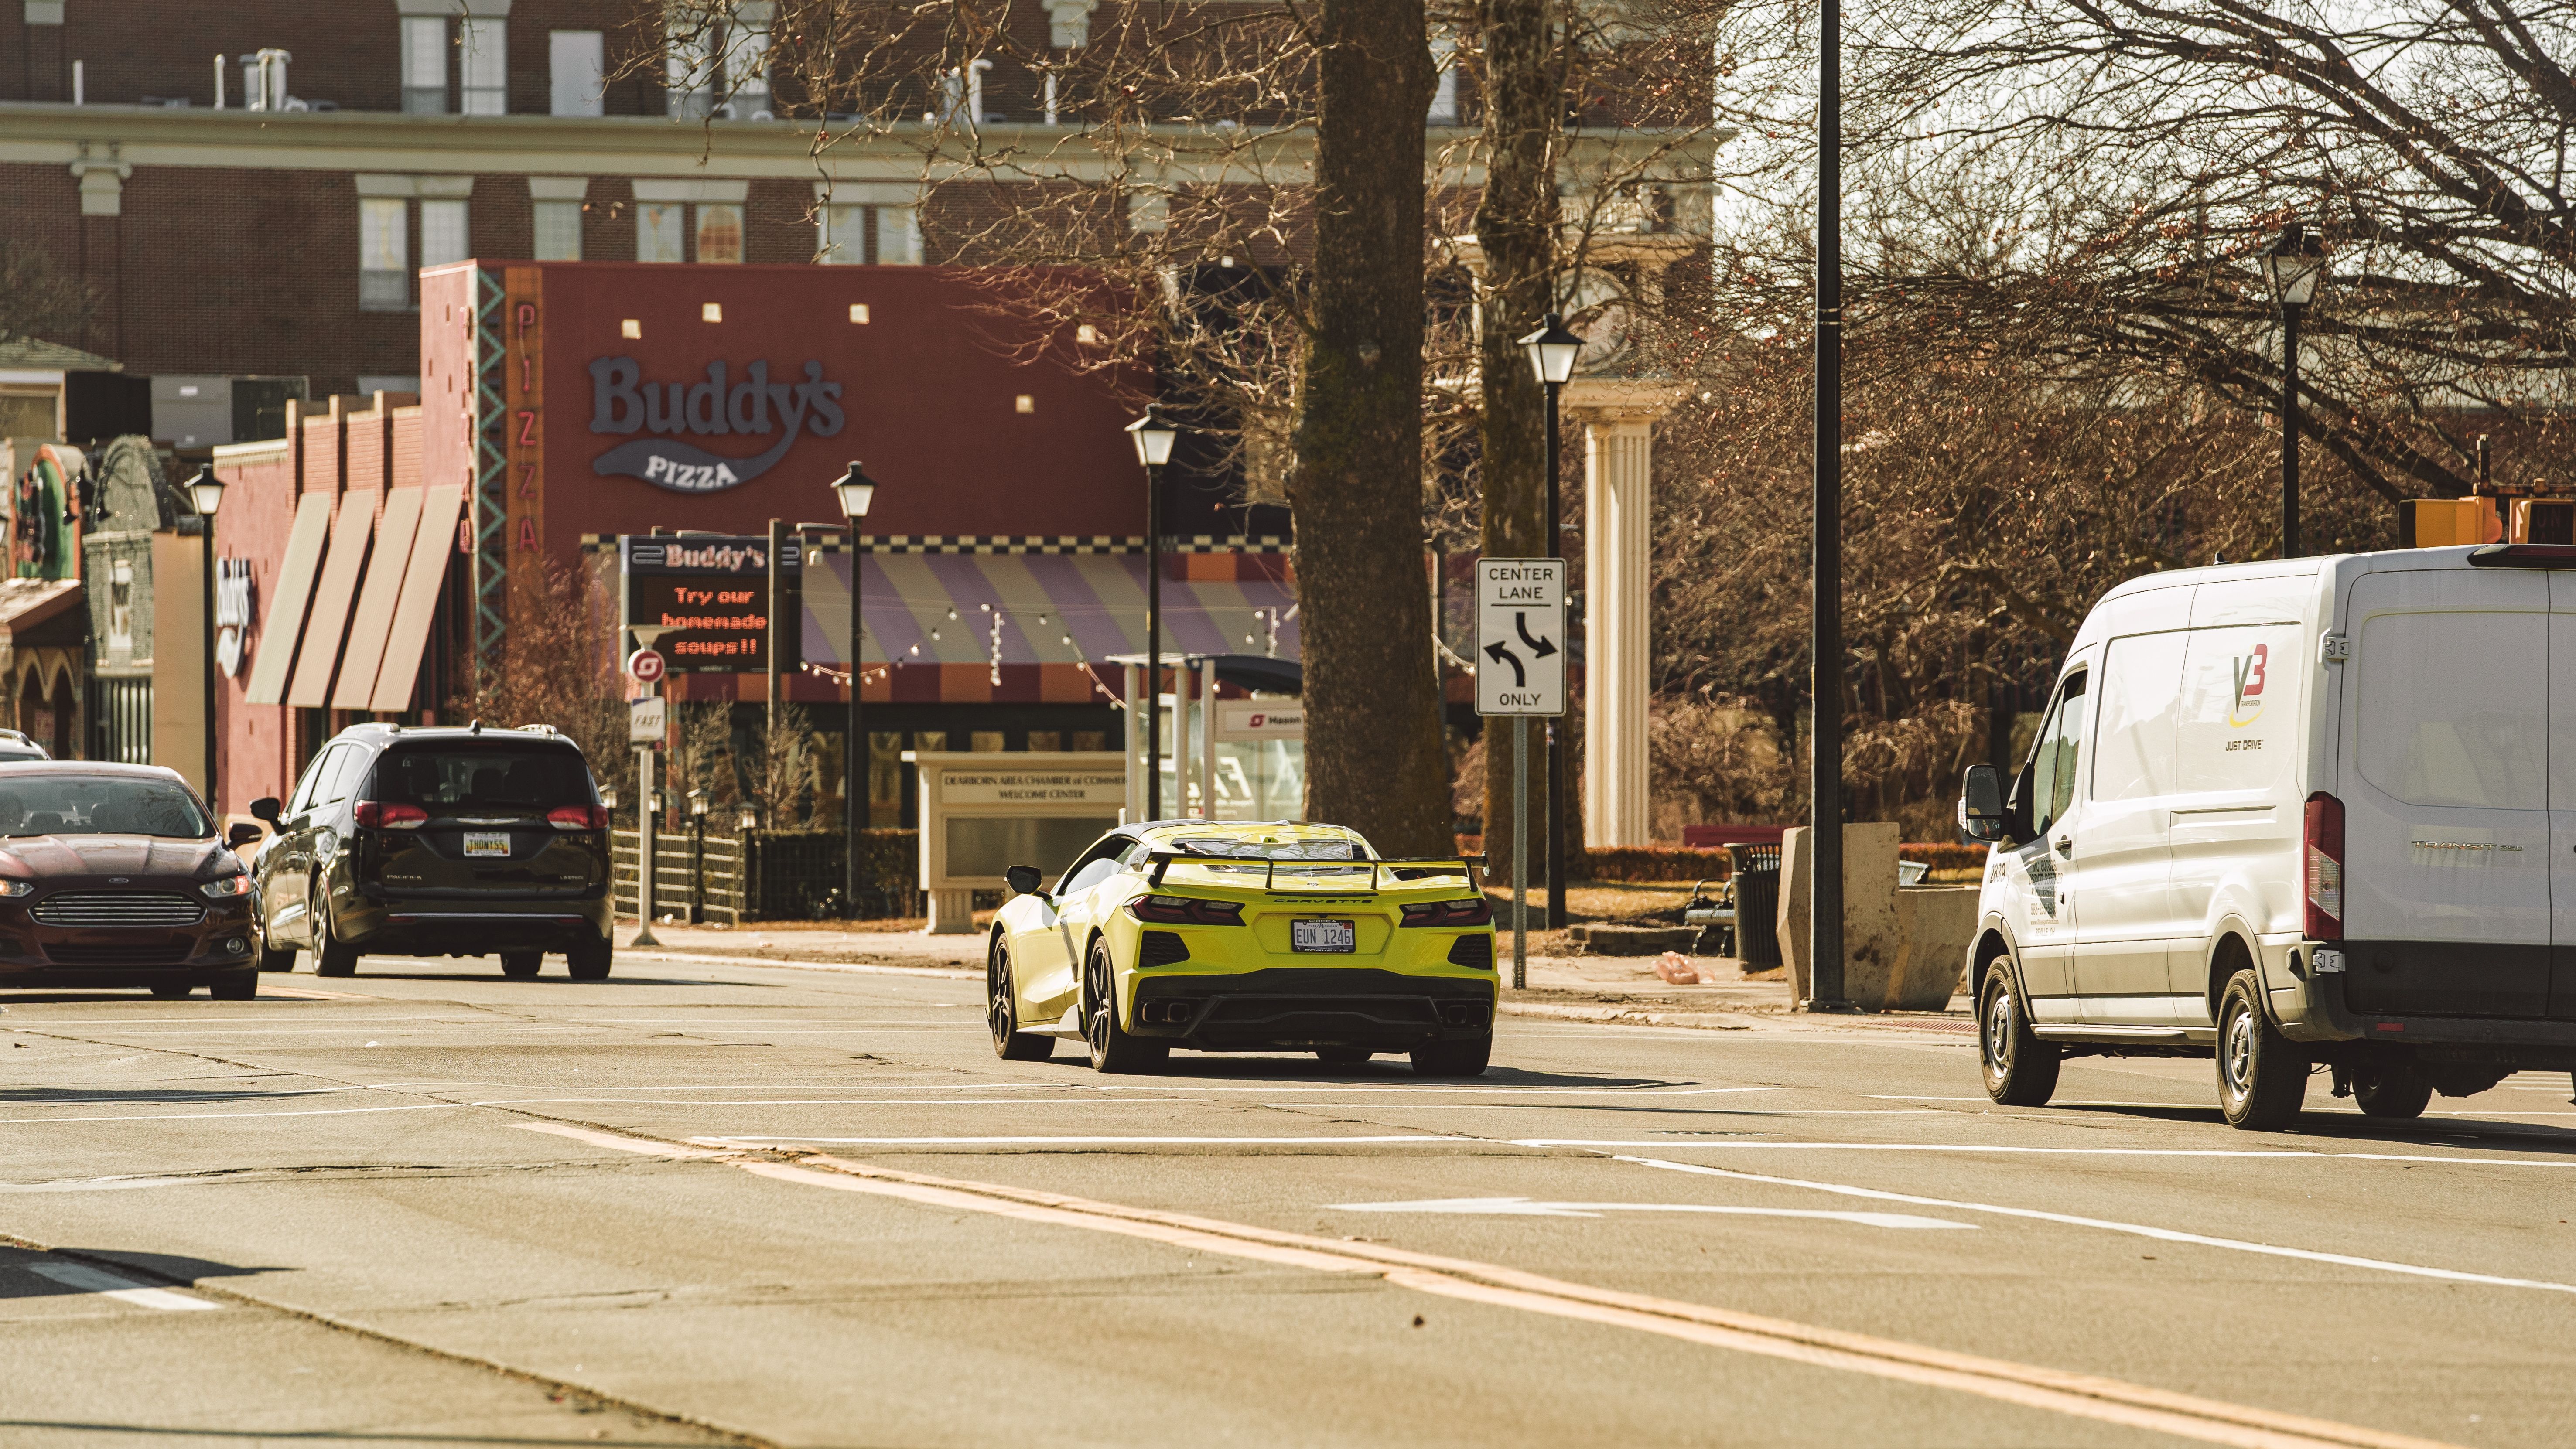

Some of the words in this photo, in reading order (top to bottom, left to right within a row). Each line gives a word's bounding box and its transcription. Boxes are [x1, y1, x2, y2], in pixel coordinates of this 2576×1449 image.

[588, 357, 845, 436] Buddy's
[518, 304, 539, 552] PIZZA
[645, 454, 738, 489] PIZZA
[665, 544, 765, 572] Buddy's
[1489, 568, 1553, 580] CENTER
[674, 587, 713, 606] Try
[717, 591, 755, 604] our
[1499, 587, 1543, 599] LANE
[674, 638, 757, 656] soups!!
[2233, 644, 2268, 714] V3
[1499, 693, 1541, 705] ONLY
[634, 715, 662, 726] FAST
[2226, 740, 2241, 751] JUST
[2243, 739, 2262, 750] DRIVE
[944, 776, 997, 784] DEARBORN
[1000, 776, 1023, 784] AREA
[1025, 776, 1070, 784] CHAMBER
[1073, 776, 1082, 784] of
[999, 790, 1046, 798] WELCOME
[1049, 790, 1085, 798] CENTER
[2411, 840, 2497, 850] TRANSIT
[1990, 863, 2005, 883] 2839
[2029, 873, 2043, 885] USDOT
[1296, 929, 1316, 944] EUN
[1323, 929, 1351, 944] 1246
